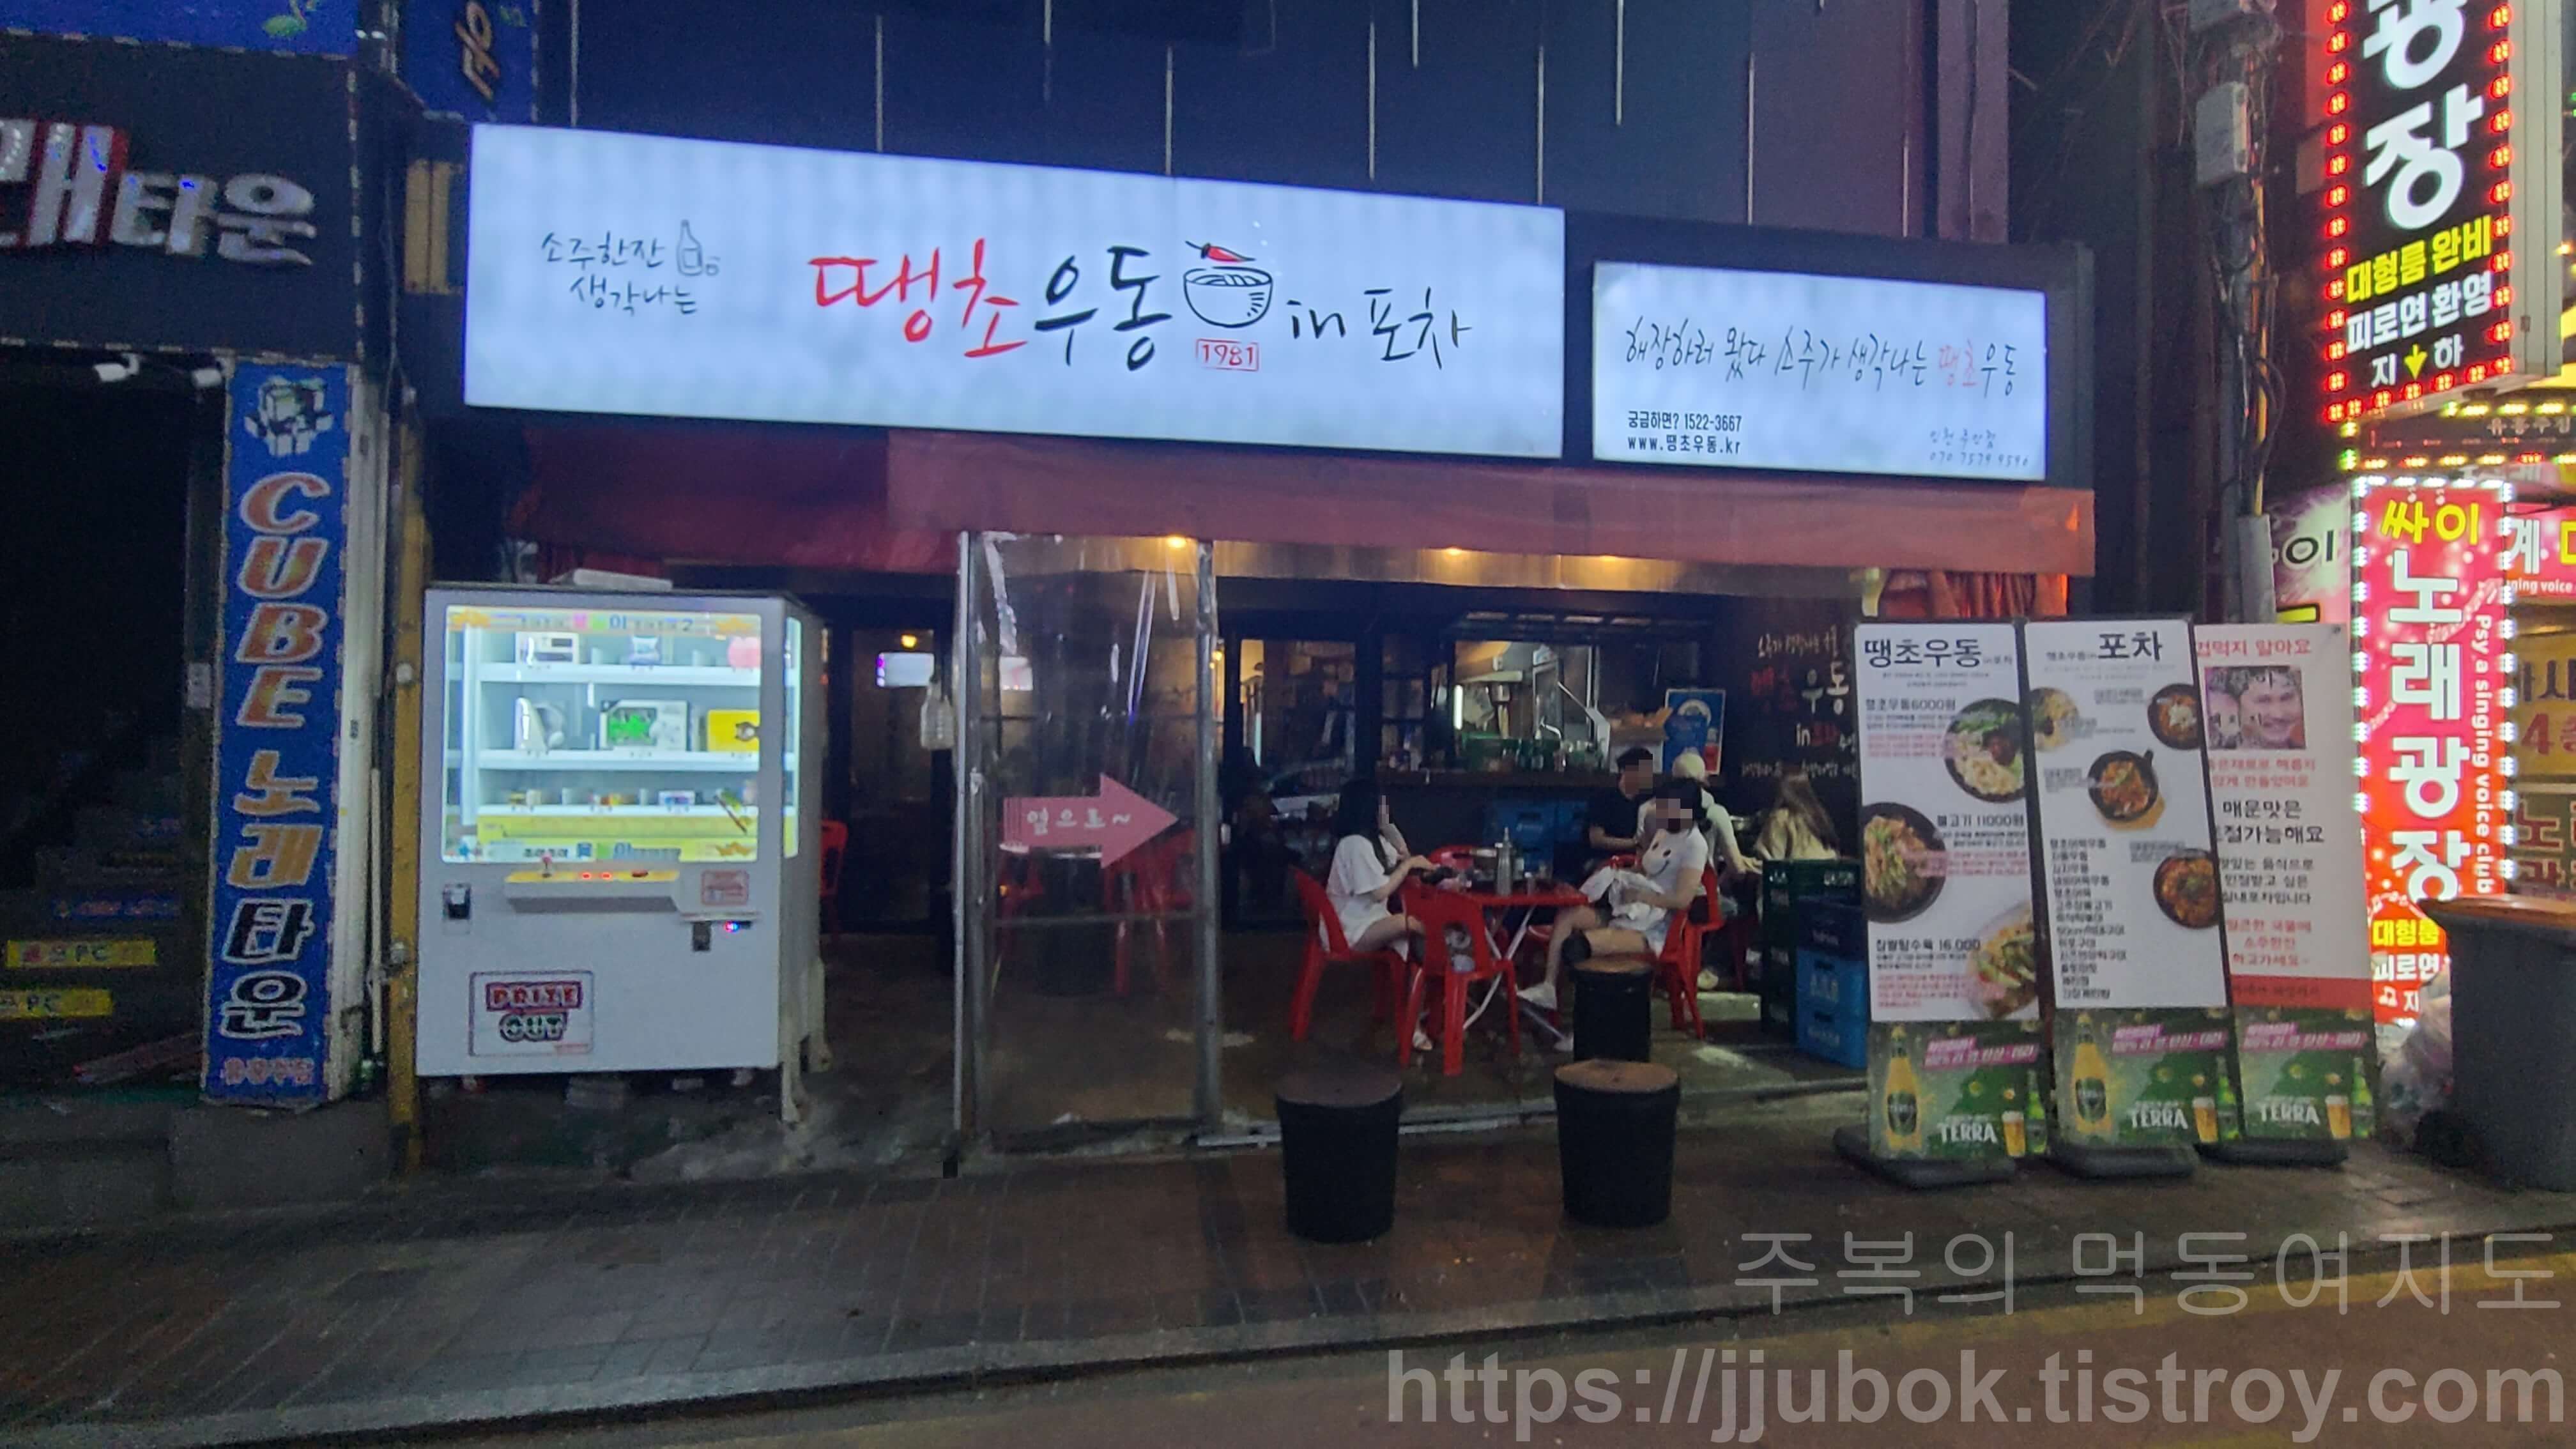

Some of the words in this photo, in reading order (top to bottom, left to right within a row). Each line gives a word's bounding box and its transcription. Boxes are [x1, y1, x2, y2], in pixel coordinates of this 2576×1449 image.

[540, 232, 666, 271] 소주한잔
[2346, 240, 2426, 303] 대형룸
[2432, 215, 2493, 275] 완비
[569, 275, 698, 316] 생각나는
[2346, 294, 2427, 353] 피로연
[2432, 271, 2493, 327] 환영
[1287, 299, 1347, 340] in
[1364, 286, 1473, 371] 포차
[1200, 342, 1256, 367] 1981
[1625, 316, 1715, 371] 해장하러
[1724, 326, 1767, 382] 왔다
[1774, 325, 1841, 389] 소주가
[1848, 332, 1928, 392] 생각나는
[1937, 339, 2018, 398] 땡초우동
[1627, 410, 1680, 431] 궁금하면?
[1683, 413, 1743, 433] 1522-3667
[1627, 436, 1742, 456] www.땡초우동.kr
[2380, 500, 2480, 546] 싸이
[235, 470, 333, 728] CUBE
[1864, 638, 1982, 668] 땡초우동
[2098, 631, 2163, 662] 포차
[2471, 615, 2492, 654] Psy
[2474, 659, 2490, 673] a
[2471, 680, 2493, 767] singing
[2223, 799, 2302, 819] 매운맛은
[2475, 774, 2493, 838] voice
[2475, 843, 2494, 894] club
[220, 749, 324, 1039] 노래타운
[2372, 919, 2439, 947] 대형룸
[1936, 1122, 1998, 1144] TERRA
[2130, 1108, 2188, 1130] TERRA
[2260, 1101, 2320, 1126] TERRA
